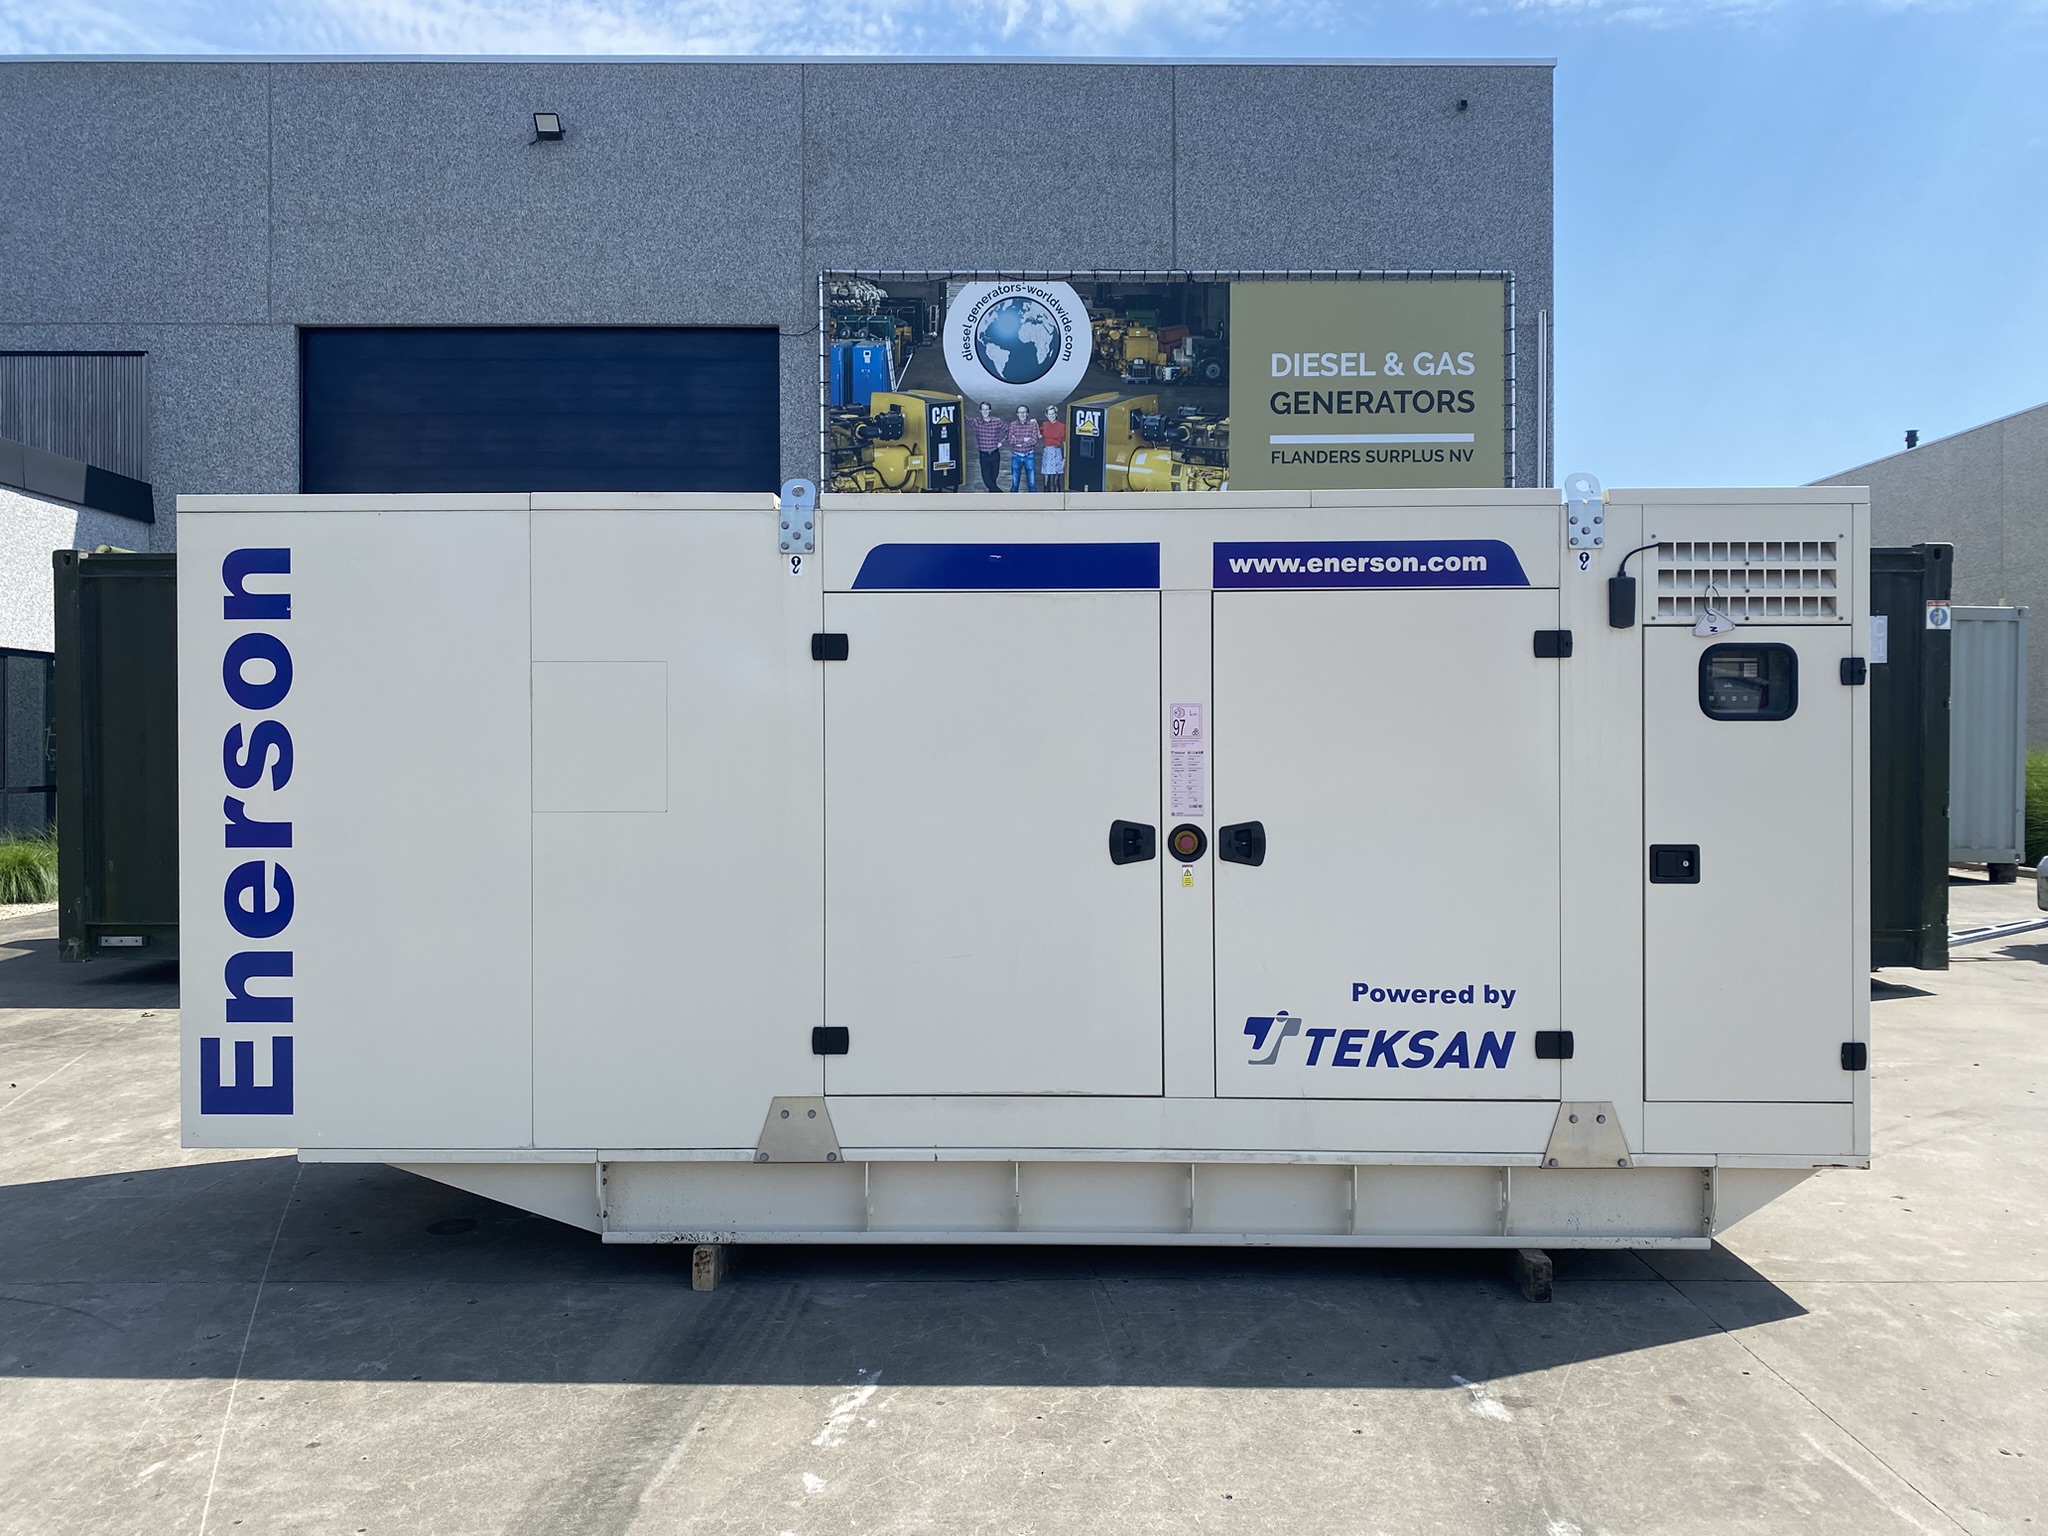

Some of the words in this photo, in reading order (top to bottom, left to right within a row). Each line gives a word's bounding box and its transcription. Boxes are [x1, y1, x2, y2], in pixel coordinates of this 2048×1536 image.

[967, 283, 1073, 362] generators-worldwide.com
[961, 323, 974, 362] diesel
[1271, 352, 1376, 377] DIESEL
[1383, 351, 1405, 376] &
[1413, 351, 1476, 376] GAS
[931, 405, 956, 425] CAT
[1269, 389, 1476, 415] GENERATORS
[1075, 409, 1101, 429] CAT
[1271, 450, 1361, 464] FLANDERS
[1365, 449, 1445, 463] SURPLUS
[1449, 448, 1475, 462] NV
[1229, 554, 1487, 574] www.enerson.com
[1173, 718, 1187, 737] 97
[199, 547, 295, 1116] Enerson
[1352, 982, 1475, 1005] Powered
[1484, 984, 1517, 1009] by
[1305, 1028, 1517, 1070] TEKSAN
